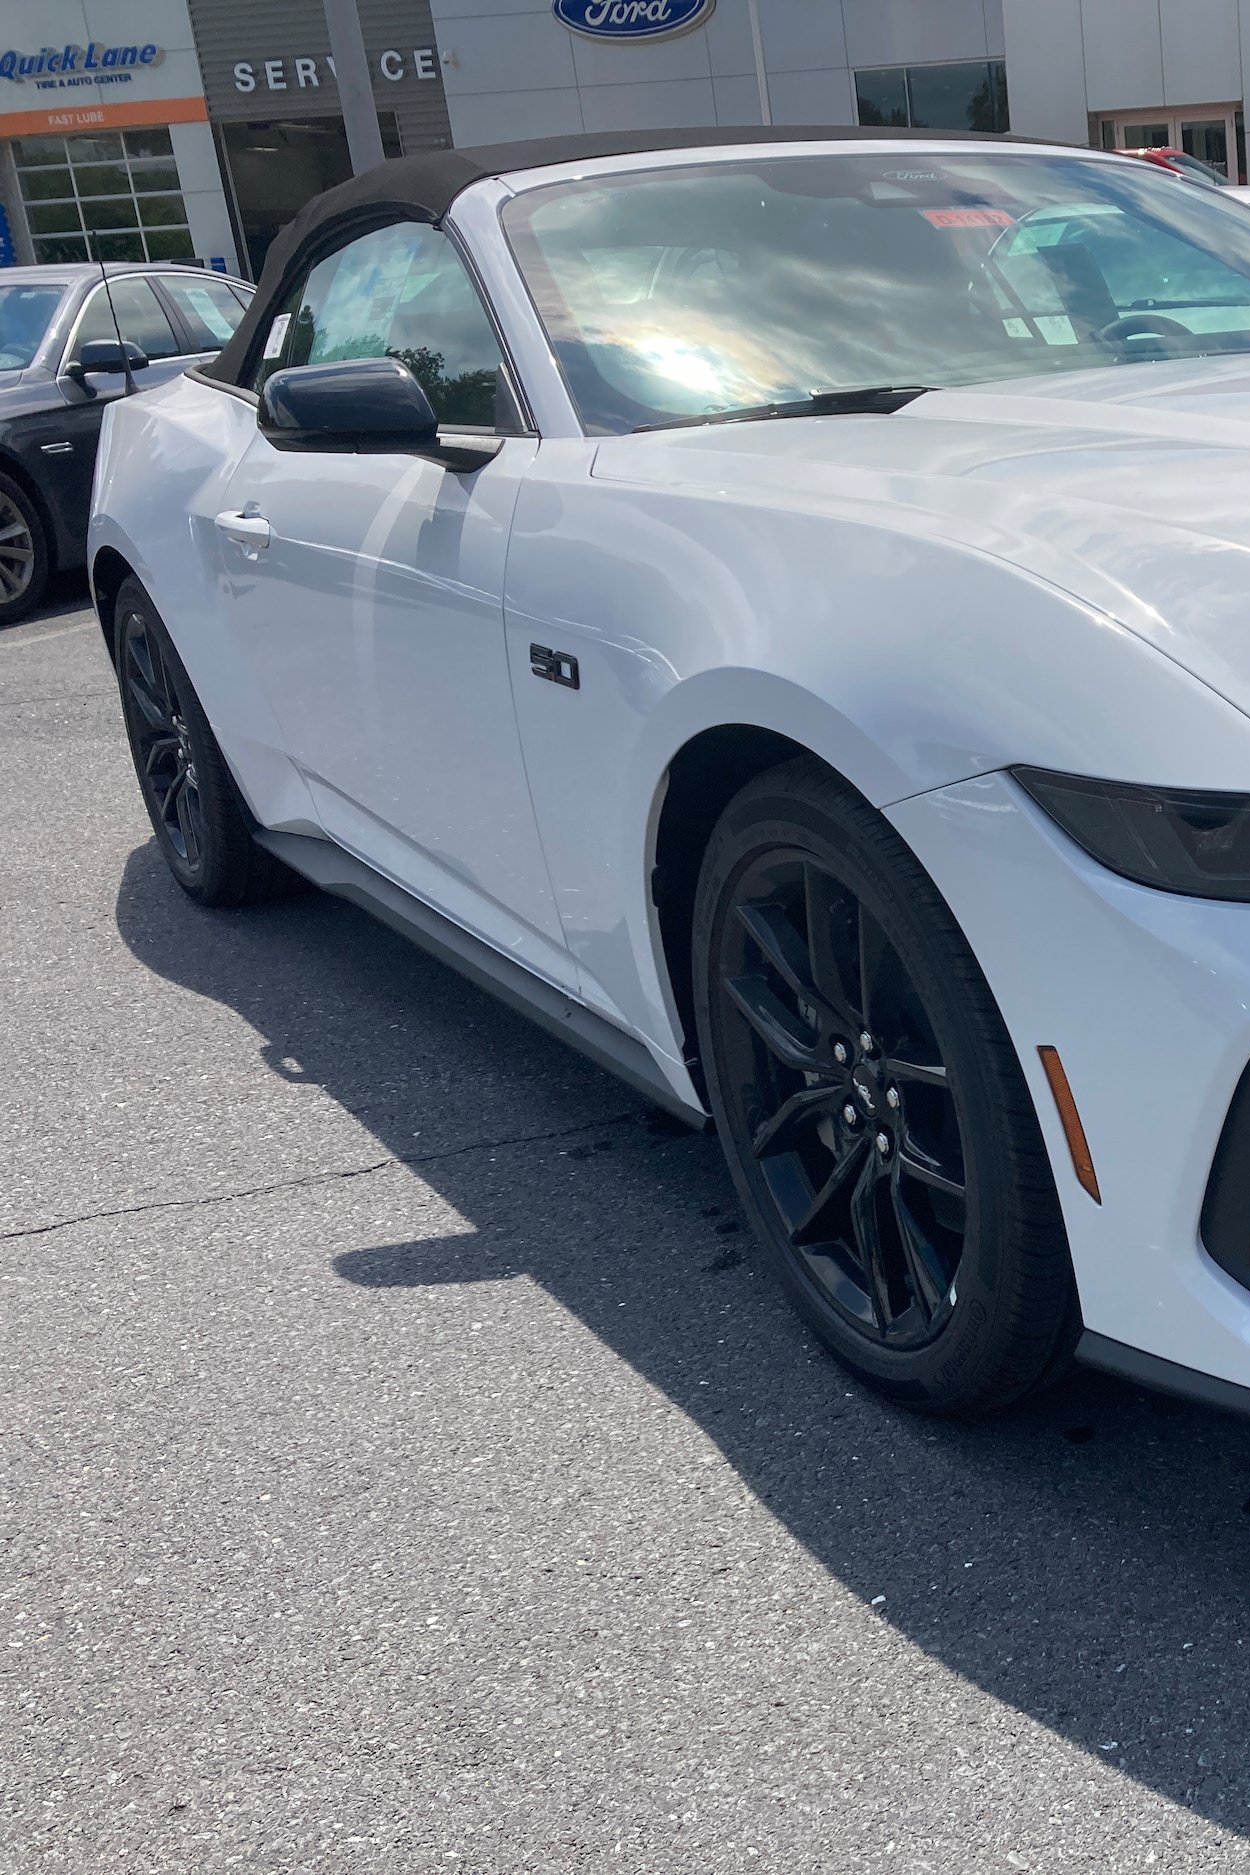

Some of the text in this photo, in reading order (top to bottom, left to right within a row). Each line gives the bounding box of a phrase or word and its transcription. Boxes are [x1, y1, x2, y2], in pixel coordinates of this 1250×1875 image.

[584, 0, 672, 26] Ford
[0, 42, 157, 80] Quick Lane
[233, 49, 436, 92] SERCE
[35, 80, 57, 90] TIRE
[67, 77, 93, 87] AUTO
[94, 73, 132, 84] CENTER
[48, 111, 104, 125] FAST LUBE
[896, 170, 937, 180] Ford
